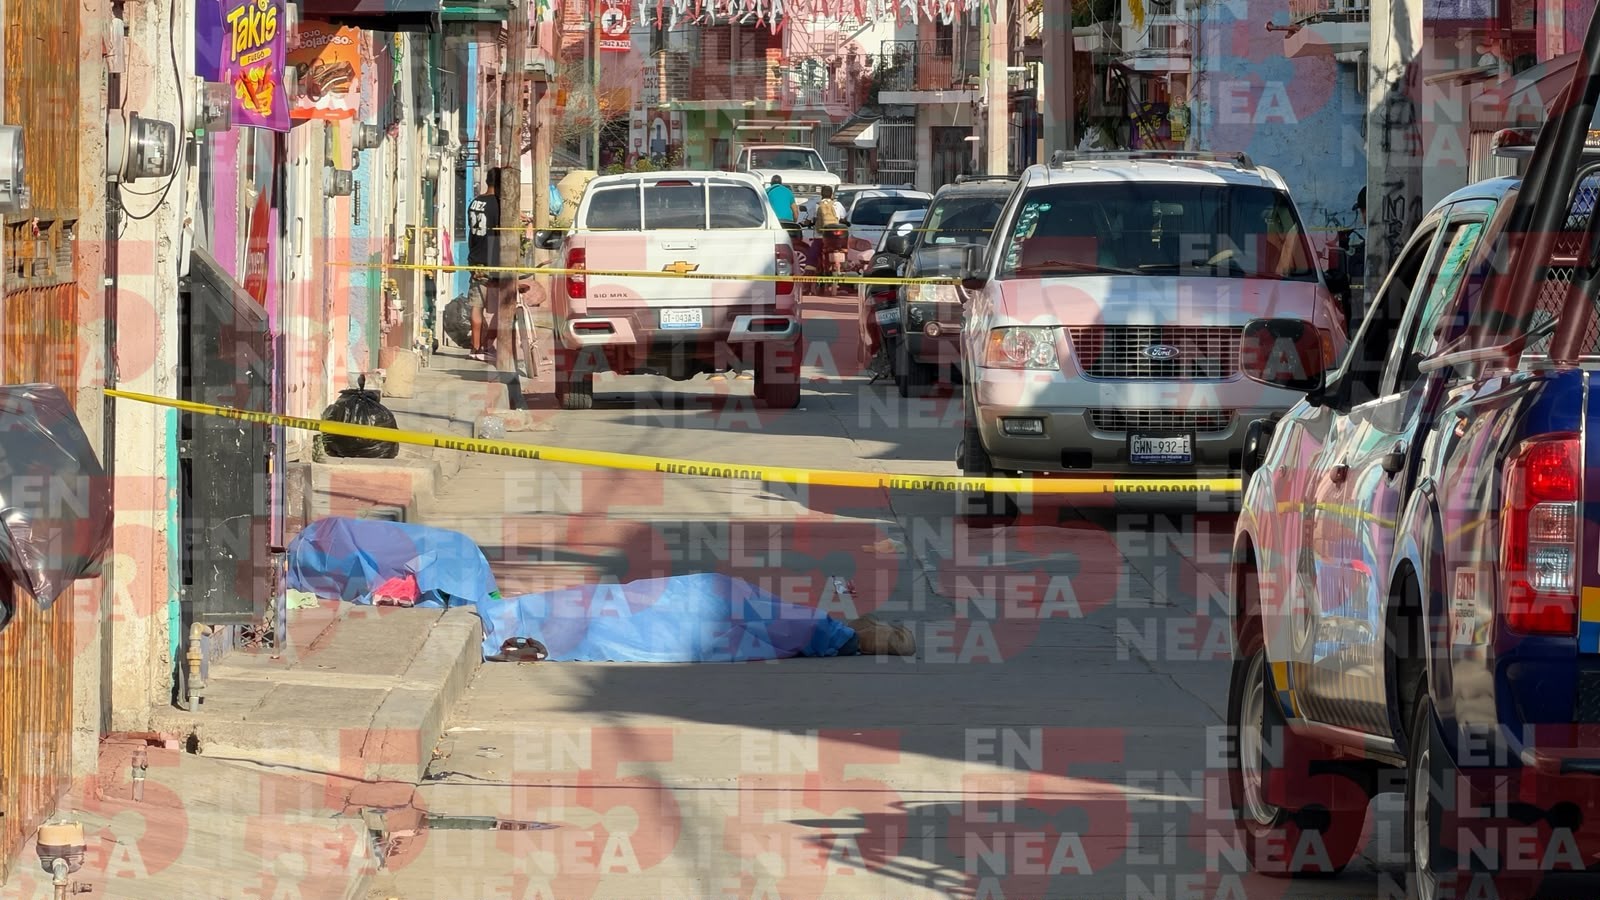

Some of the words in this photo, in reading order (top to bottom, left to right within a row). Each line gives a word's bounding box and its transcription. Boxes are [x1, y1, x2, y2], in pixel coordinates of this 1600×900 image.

[227, 4, 277, 62] Takis
[247, 51, 265, 63] FUEGO
[1151, 347, 1171, 356] Ford
[1133, 441, 1189, 454] GWN-932-E
